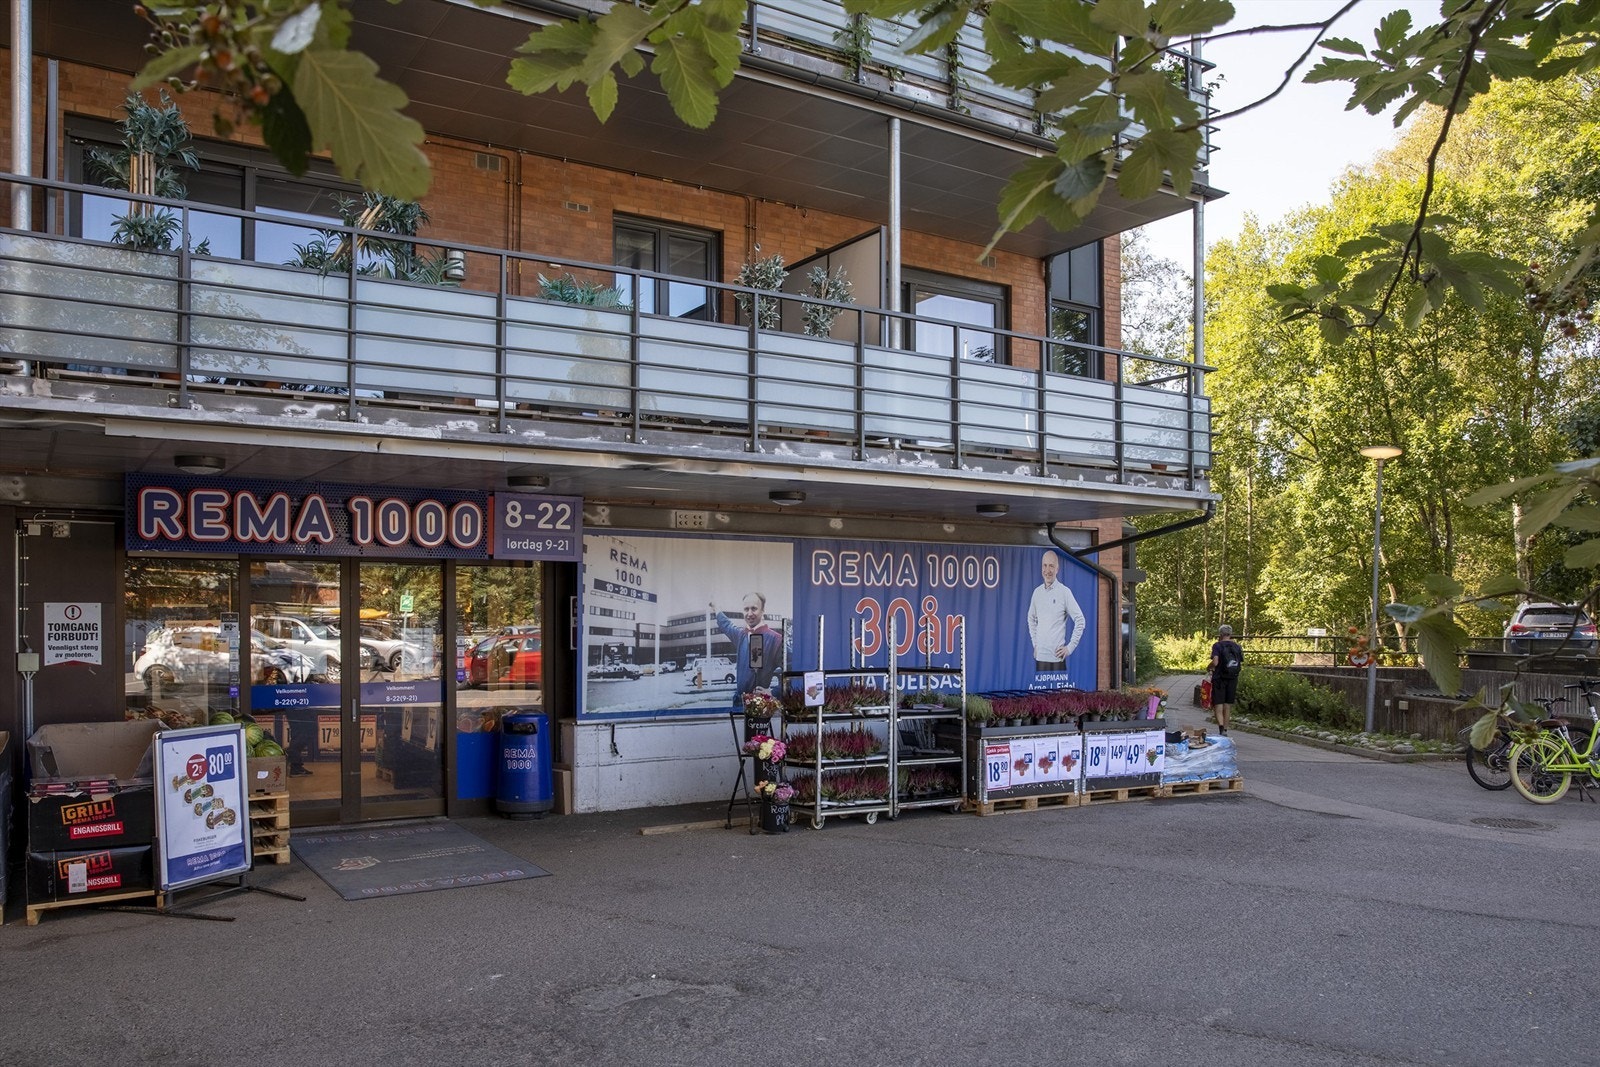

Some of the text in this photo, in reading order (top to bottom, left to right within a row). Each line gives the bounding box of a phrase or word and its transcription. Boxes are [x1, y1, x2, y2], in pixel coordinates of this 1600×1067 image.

[138, 486, 482, 548] REMA 1000
[505, 500, 571, 530] 8-22
[506, 538, 570, 551] lørdag 9-21
[610, 548, 648, 573] REMA
[812, 549, 1000, 588] REMA 1000
[615, 569, 642, 586] 1000
[48, 622, 98, 632] TOMGANG
[48, 632, 98, 641] FORBUDT!
[274, 698, 310, 706] 8-22(9-21)
[504, 748, 536, 758] REMA
[1090, 746, 1101, 767] 18
[1111, 745, 1123, 760] 149
[1126, 744, 1140, 765] 49
[209, 753, 224, 775] 80
[507, 759, 532, 770] 1000
[988, 761, 1000, 782] 18
[65, 801, 111, 820] GRILL
[73, 823, 121, 835] ENGANGSGRILL
[63, 855, 109, 875] GILL
